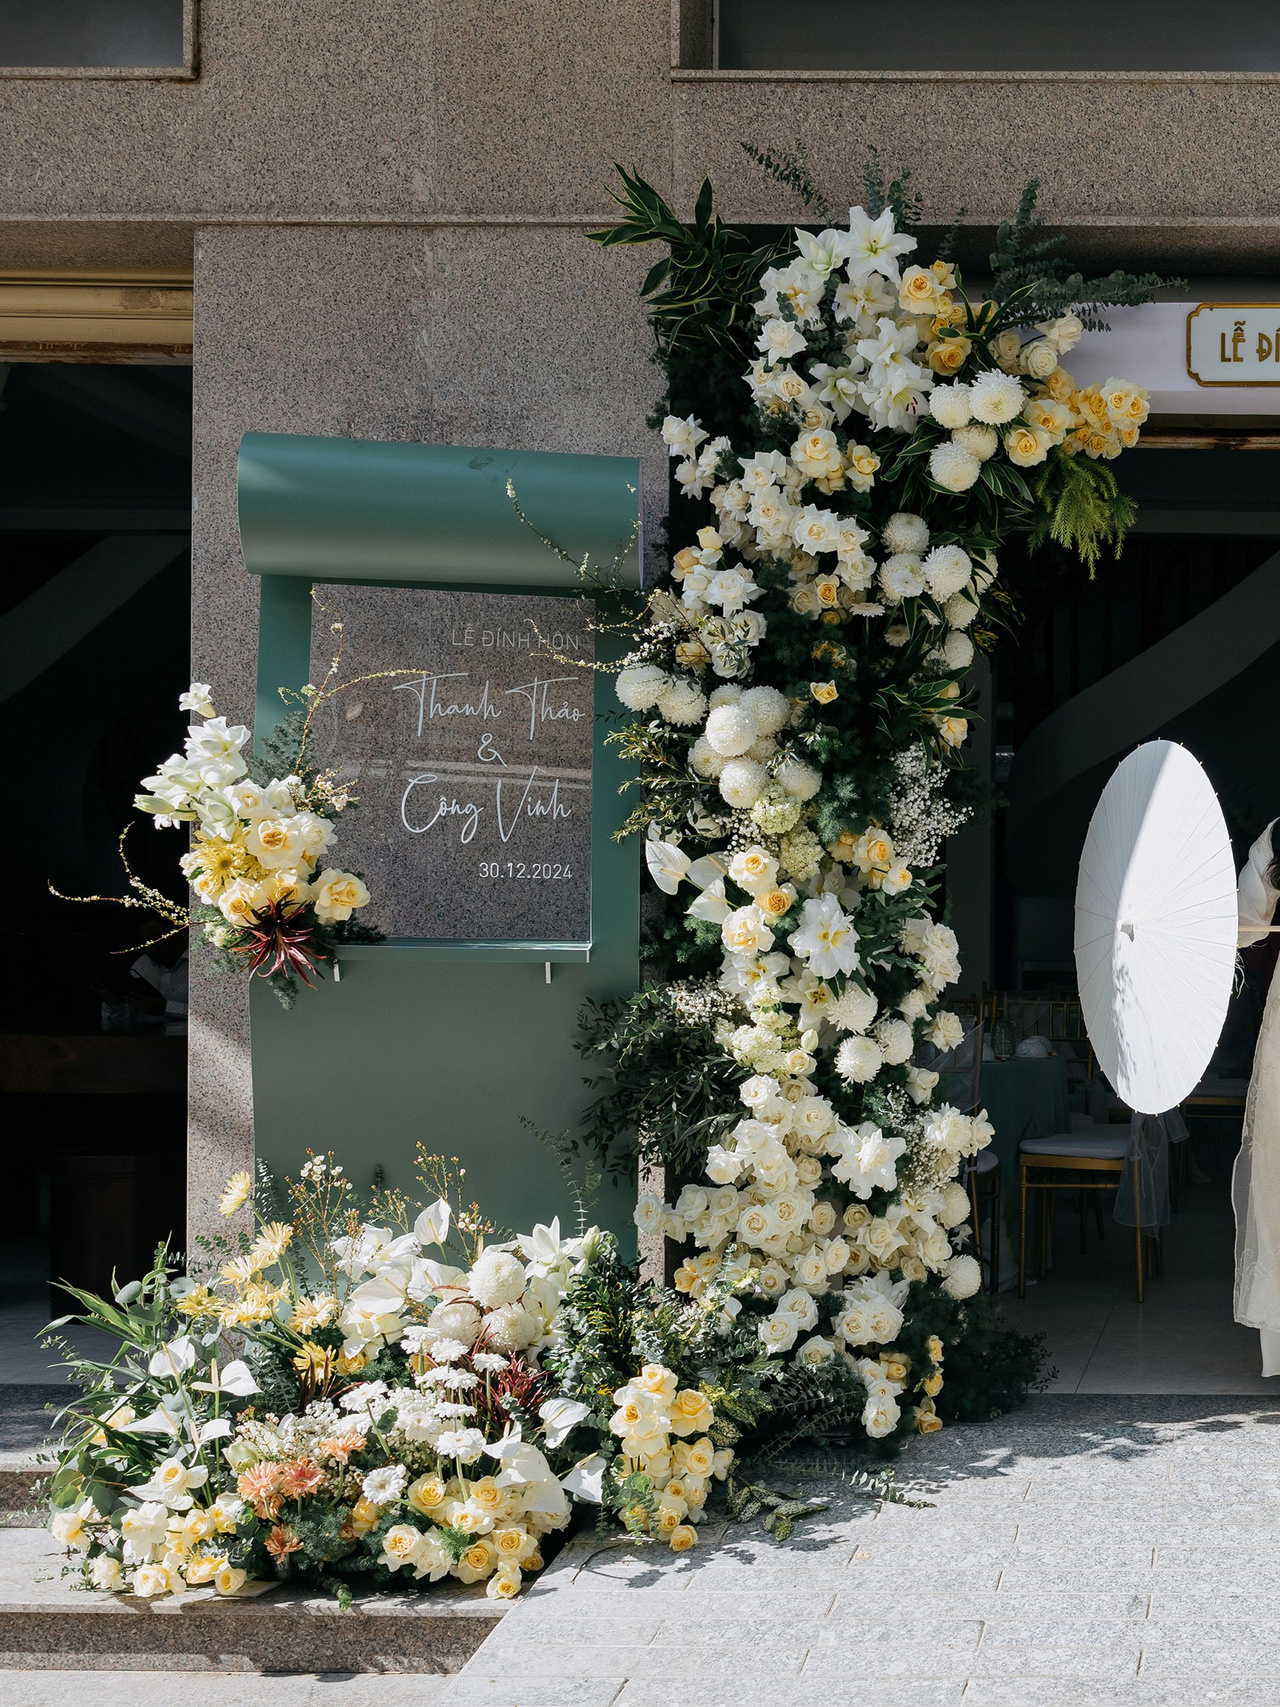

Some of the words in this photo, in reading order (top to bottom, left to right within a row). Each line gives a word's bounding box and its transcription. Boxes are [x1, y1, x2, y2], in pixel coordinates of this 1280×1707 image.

[1220, 320, 1246, 362] LỄ
[452, 623, 475, 646] LỄ
[481, 627, 530, 649] ĐÍNH
[538, 630, 579, 650] HÔN
[392, 673, 502, 736] Thanh
[505, 676, 586, 740] Thảo
[478, 733, 507, 767] &
[401, 774, 484, 844] Công
[479, 862, 573, 879] 30.12.2024
